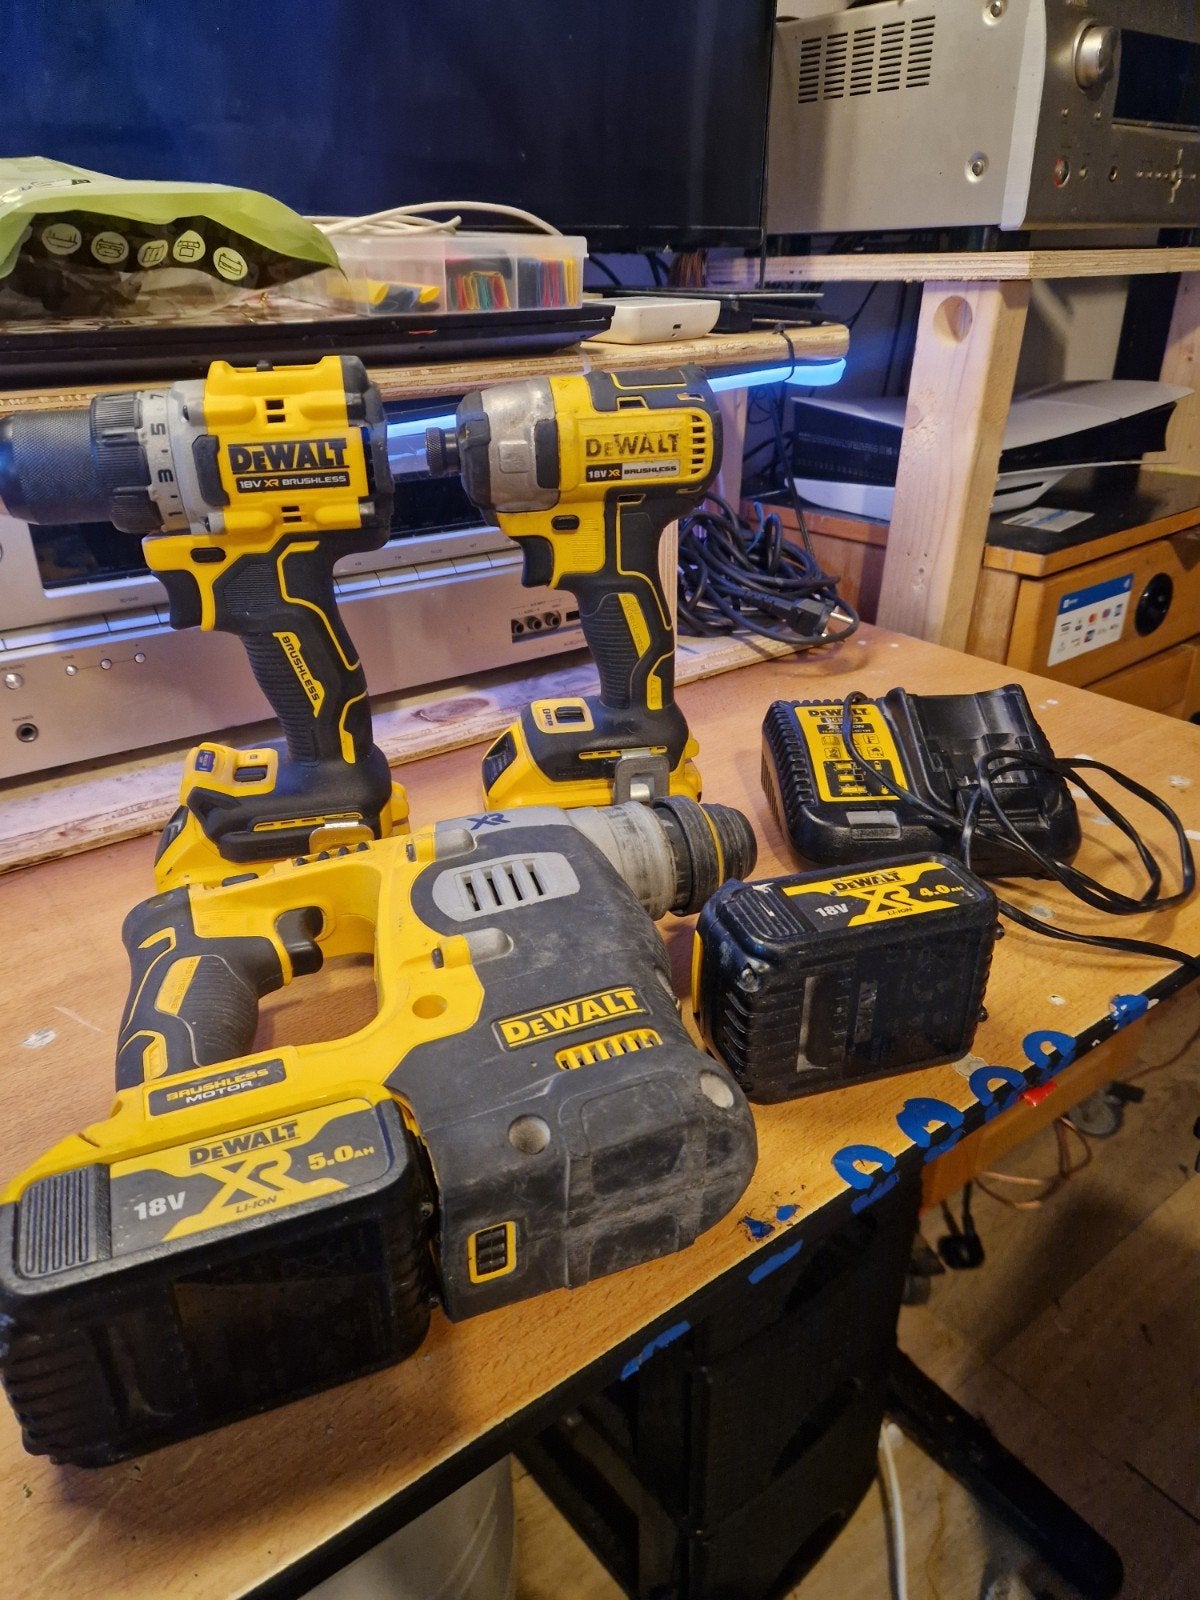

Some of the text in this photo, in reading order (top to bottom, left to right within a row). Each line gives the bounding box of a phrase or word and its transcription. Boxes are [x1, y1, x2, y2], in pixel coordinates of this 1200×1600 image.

[151, 423, 166, 436] 5
[158, 469, 174, 482] 3
[240, 475, 347, 489] 18V XR BRUSHLESS
[588, 466, 677, 479] 18V XR BRUSHLESS
[282, 635, 321, 701] BRUSHLESS
[466, 812, 511, 831] XR
[853, 885, 919, 916] XR
[814, 903, 849, 918] 18V
[888, 907, 913, 916] LI-ION
[166, 1068, 269, 1102] BRUSHLESS
[186, 1080, 253, 1104] MOTOR
[198, 1150, 310, 1210] XR
[134, 1191, 186, 1221] 18V
[235, 1195, 278, 1214] LI-ION
